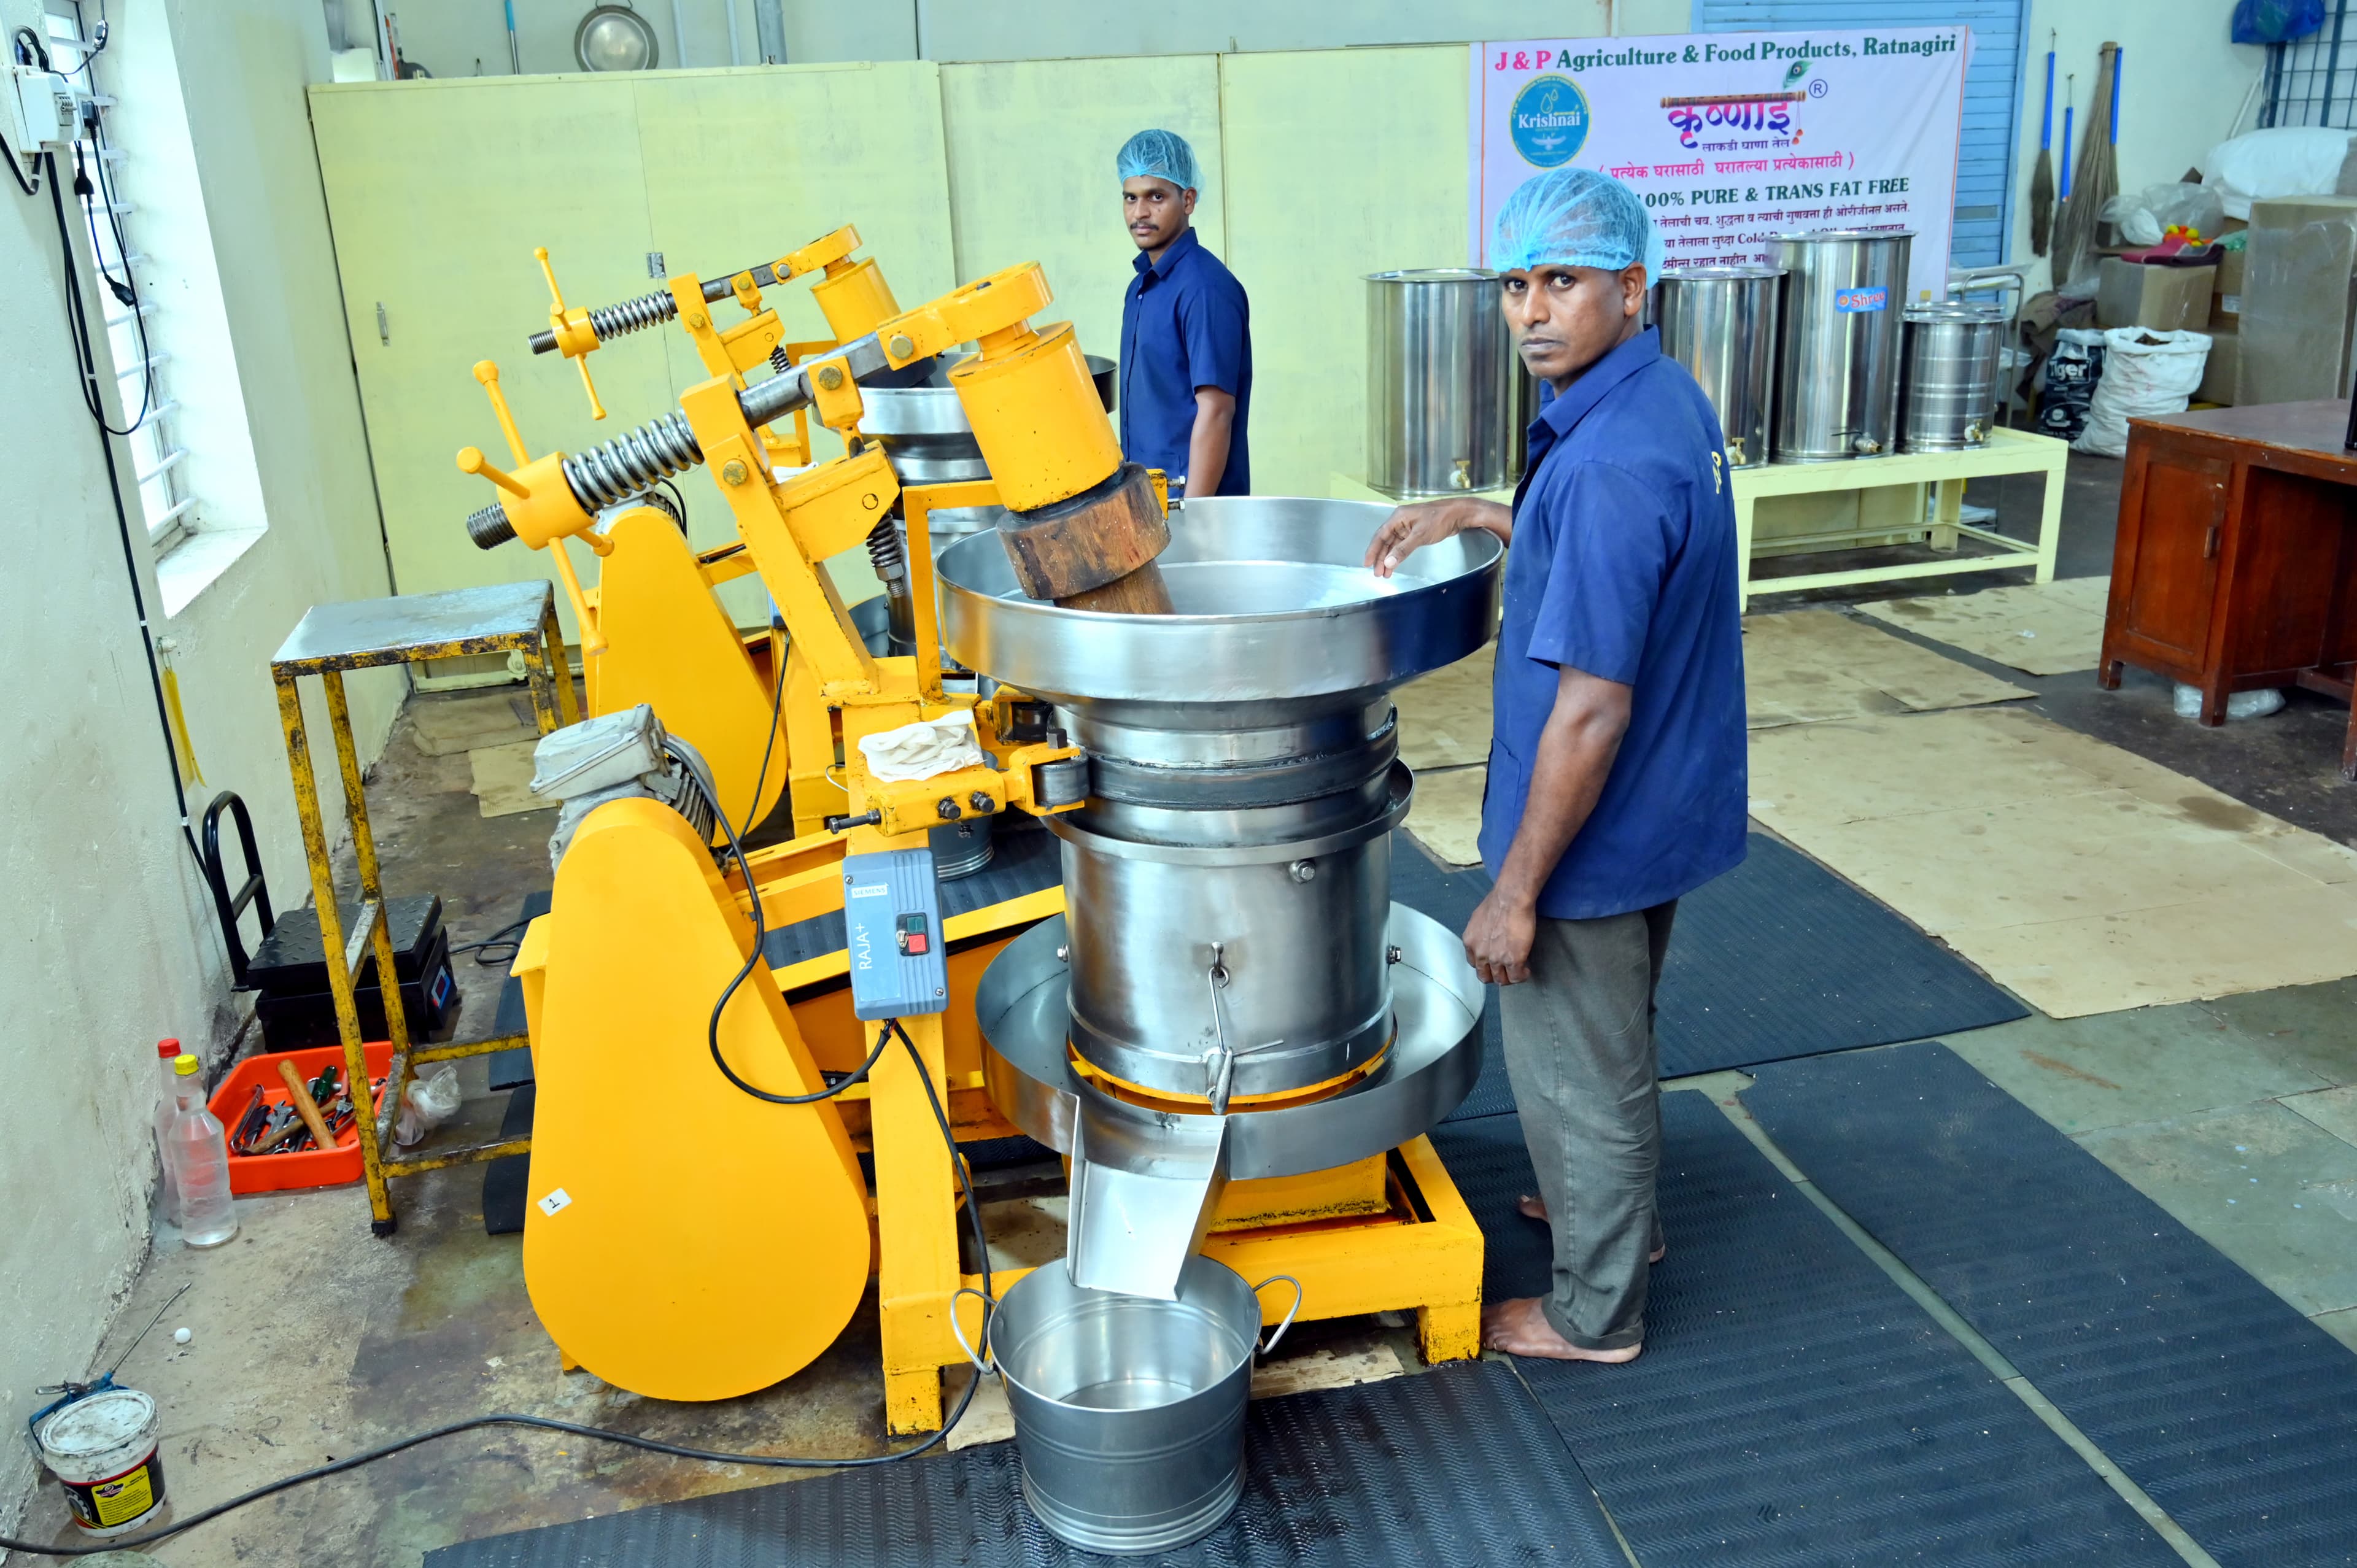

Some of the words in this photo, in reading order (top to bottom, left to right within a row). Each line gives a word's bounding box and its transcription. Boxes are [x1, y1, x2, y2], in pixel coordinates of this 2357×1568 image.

[1495, 52, 1508, 71] J
[1512, 51, 1530, 71] &
[1536, 50, 1551, 69] P
[1556, 47, 1677, 72] Agriculture
[1682, 44, 1699, 63] &
[1705, 42, 1755, 62] Food
[1761, 40, 1857, 60] Products,
[1863, 34, 1956, 56] Ratnagiri
[1519, 112, 1581, 128] Krishnai
[1701, 139, 1738, 152] लाकडी
[1772, 137, 1790, 149] तेल
[1636, 191, 1684, 208] 00%
[1691, 188, 1739, 205] PURE
[1745, 187, 1759, 201] &
[1765, 183, 1824, 201] TRANS
[1829, 180, 1863, 197] FAT
[1868, 177, 1909, 195] FREE
[1851, 292, 1885, 308] Shree
[2049, 360, 2087, 381] Tiger
[854, 887, 886, 896] SIEMENS
